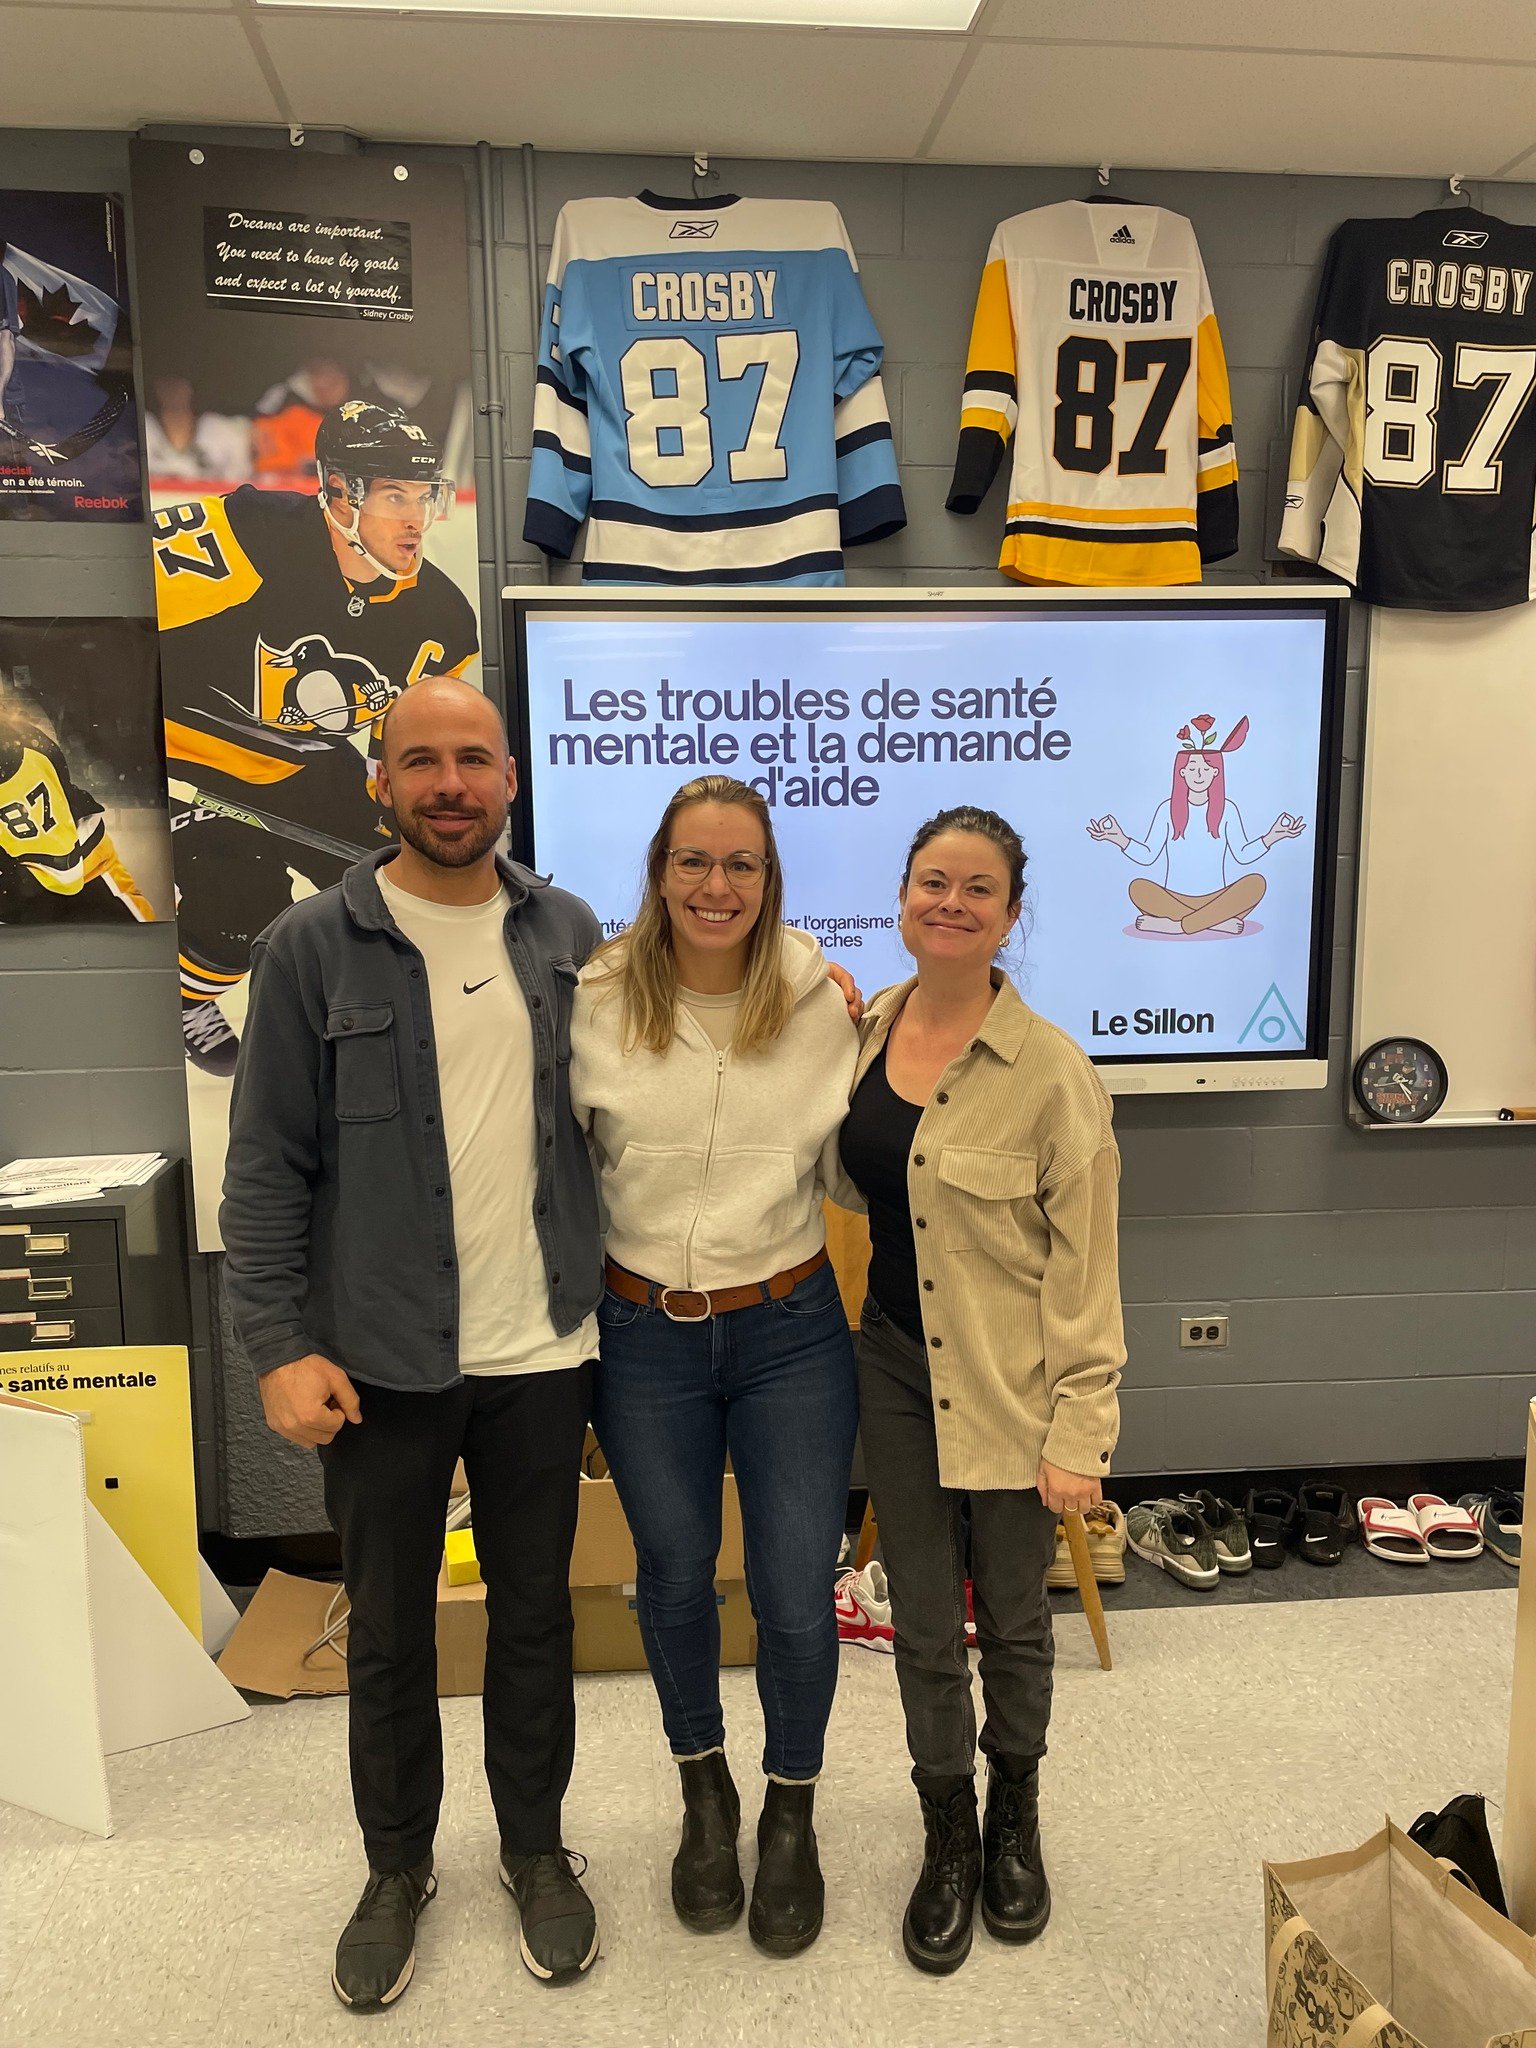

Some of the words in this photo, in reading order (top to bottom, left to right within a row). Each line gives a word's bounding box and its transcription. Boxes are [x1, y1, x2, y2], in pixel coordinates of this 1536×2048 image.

[228, 212, 284, 231] Dreams
[288, 223, 311, 234] are
[315, 223, 385, 241] important.
[1109, 236, 1136, 245] adidas
[216, 241, 247, 262] You
[251, 248, 282, 262] need
[286, 249, 300, 263] to
[304, 248, 335, 267] have
[338, 252, 360, 273] big
[364, 256, 400, 274] goals
[214, 273, 243, 287] and
[246, 277, 287, 293] expect
[291, 281, 301, 292] a
[305, 278, 325, 294] lot
[328, 280, 343, 300] of
[346, 286, 402, 305] yourself.
[631, 270, 777, 322] CROSBY
[1069, 278, 1178, 323] CROSBY
[1386, 259, 1534, 315] CROSBY
[388, 311, 415, 322] Crosby
[619, 329, 800, 488] 87
[1052, 334, 1193, 478] 87
[1363, 334, 1536, 495] 87
[411, 456, 436, 464] CCM
[3, 478, 16, 486] en
[19, 478, 25, 486] a
[28, 476, 45, 487] été
[47, 477, 85, 488] témoin.
[74, 495, 129, 509] Reebok
[152, 502, 233, 582] 87
[564, 679, 647, 721] Les
[657, 679, 850, 721] troubles
[861, 678, 920, 720] de
[931, 676, 1057, 720] santé
[549, 723, 739, 765] mentale
[750, 722, 797, 764] et
[808, 722, 846, 764] la
[857, 720, 1072, 763] demande
[749, 766, 880, 807] d'aide
[0, 781, 57, 839] 87
[170, 807, 226, 832] CC
[804, 915, 894, 933] l'organisme
[1092, 1009, 1128, 1036] Le
[1133, 1008, 1215, 1035] Sillon
[8, 1374, 69, 1393] santé
[72, 1371, 157, 1389] mentale
[20, 1362, 55, 1374] relatifs
[57, 1363, 70, 1372] au
